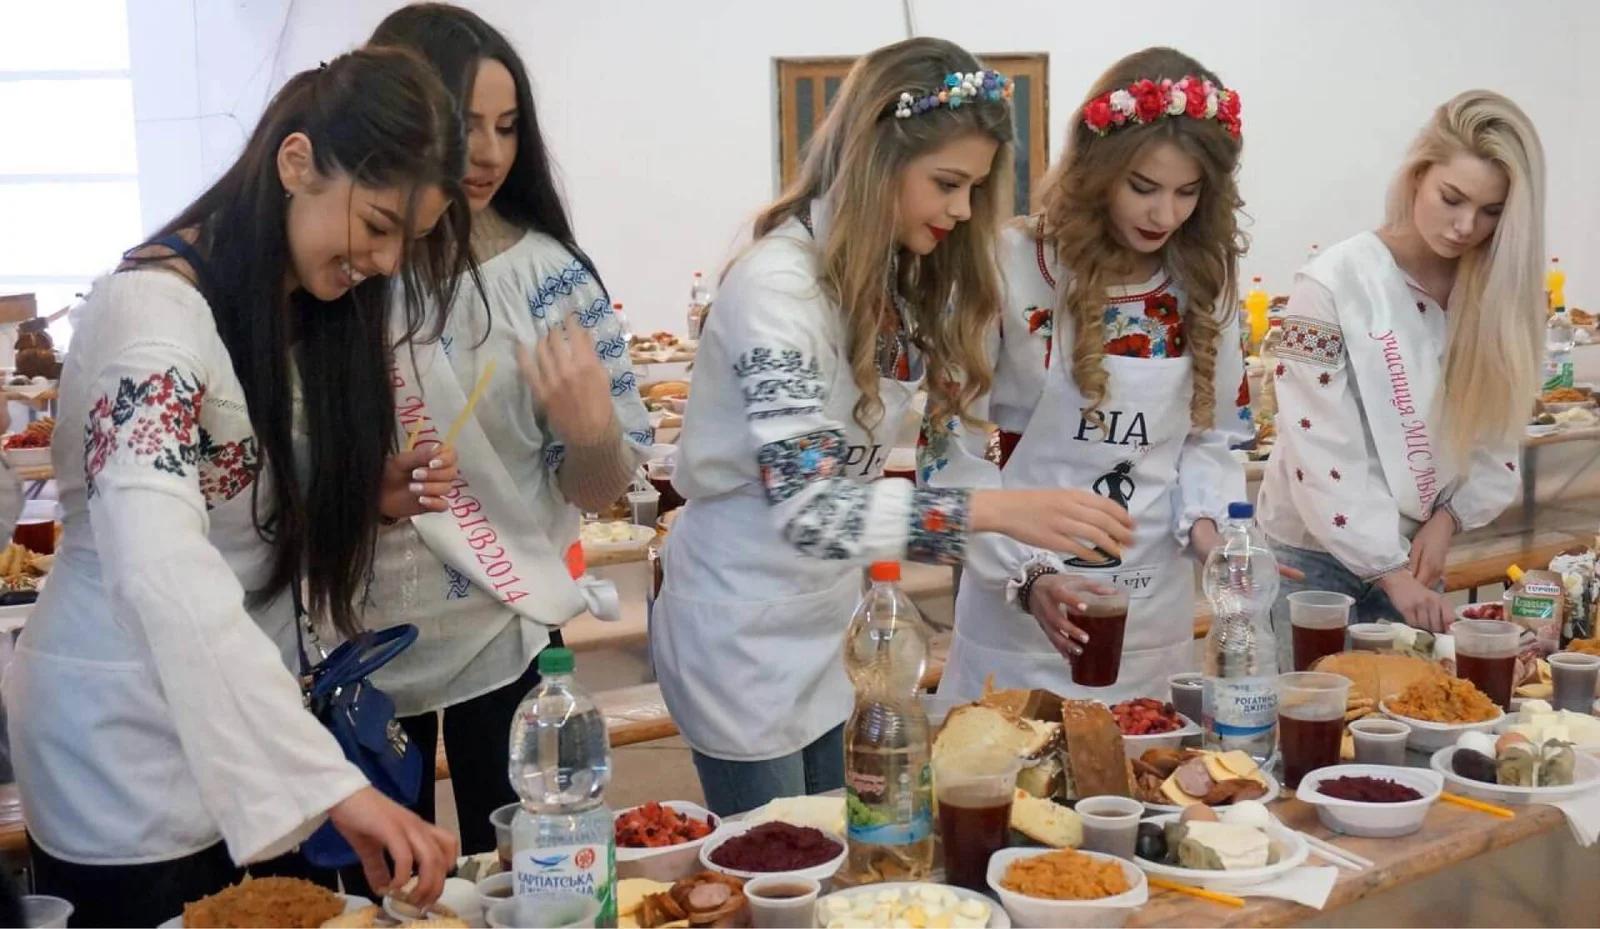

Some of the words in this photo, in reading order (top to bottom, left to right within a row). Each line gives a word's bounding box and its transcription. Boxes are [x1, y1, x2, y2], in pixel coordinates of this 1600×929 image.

[1368, 329, 1416, 416] учасниця
[842, 444, 882, 475] PI
[1401, 419, 1433, 463] МІС
[1409, 466, 1437, 519] ЛЬВ
[448, 469, 530, 604] ЬВІВ2014
